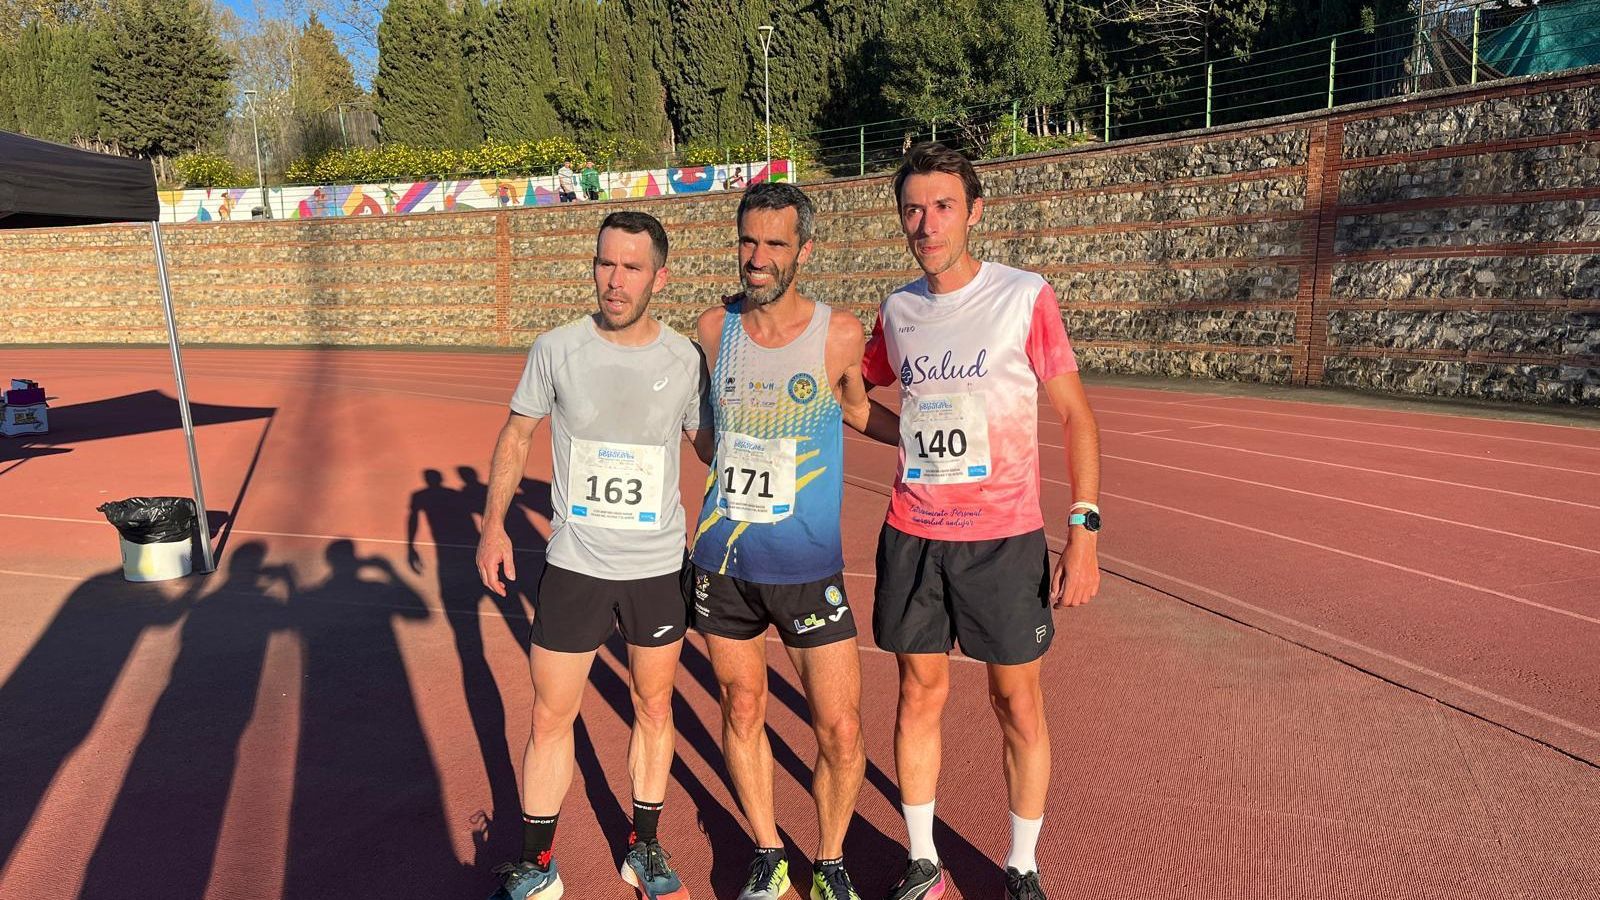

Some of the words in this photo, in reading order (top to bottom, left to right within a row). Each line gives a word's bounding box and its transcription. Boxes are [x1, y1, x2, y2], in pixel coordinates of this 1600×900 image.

[913, 348, 988, 384] Salud
[914, 428, 967, 458] 140
[585, 475, 642, 505] 163
[724, 466, 774, 498] 171
